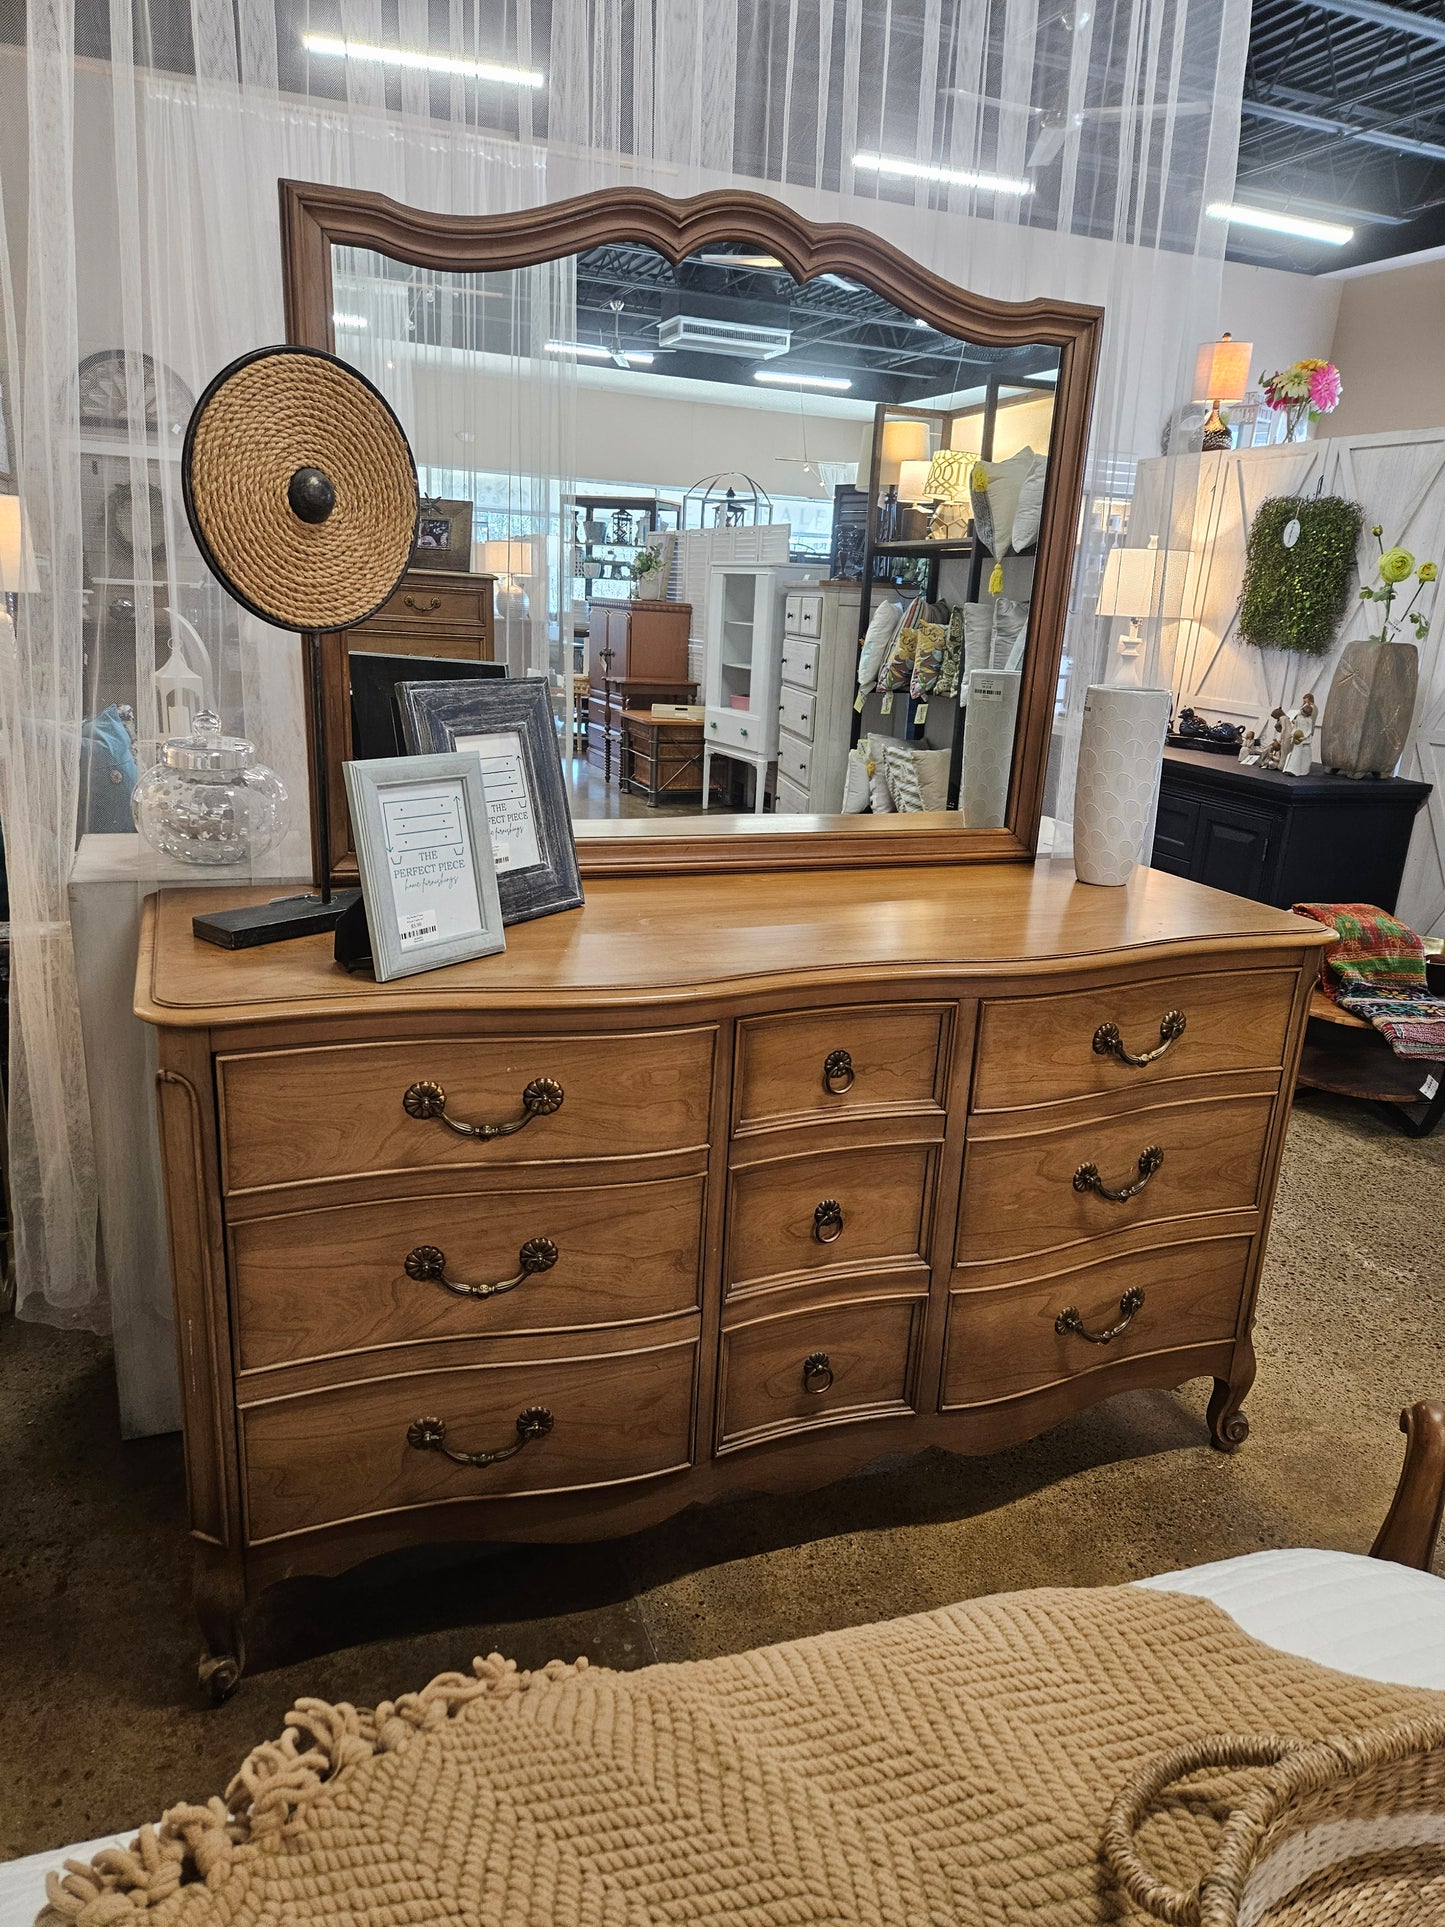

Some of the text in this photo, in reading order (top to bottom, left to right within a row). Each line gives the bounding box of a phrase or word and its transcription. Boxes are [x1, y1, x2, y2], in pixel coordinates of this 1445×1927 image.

[491, 803, 507, 812] THE
[507, 812, 528, 822] PIECE
[418, 850, 438, 861] THE
[394, 859, 465, 879] PERFECT PIECE
